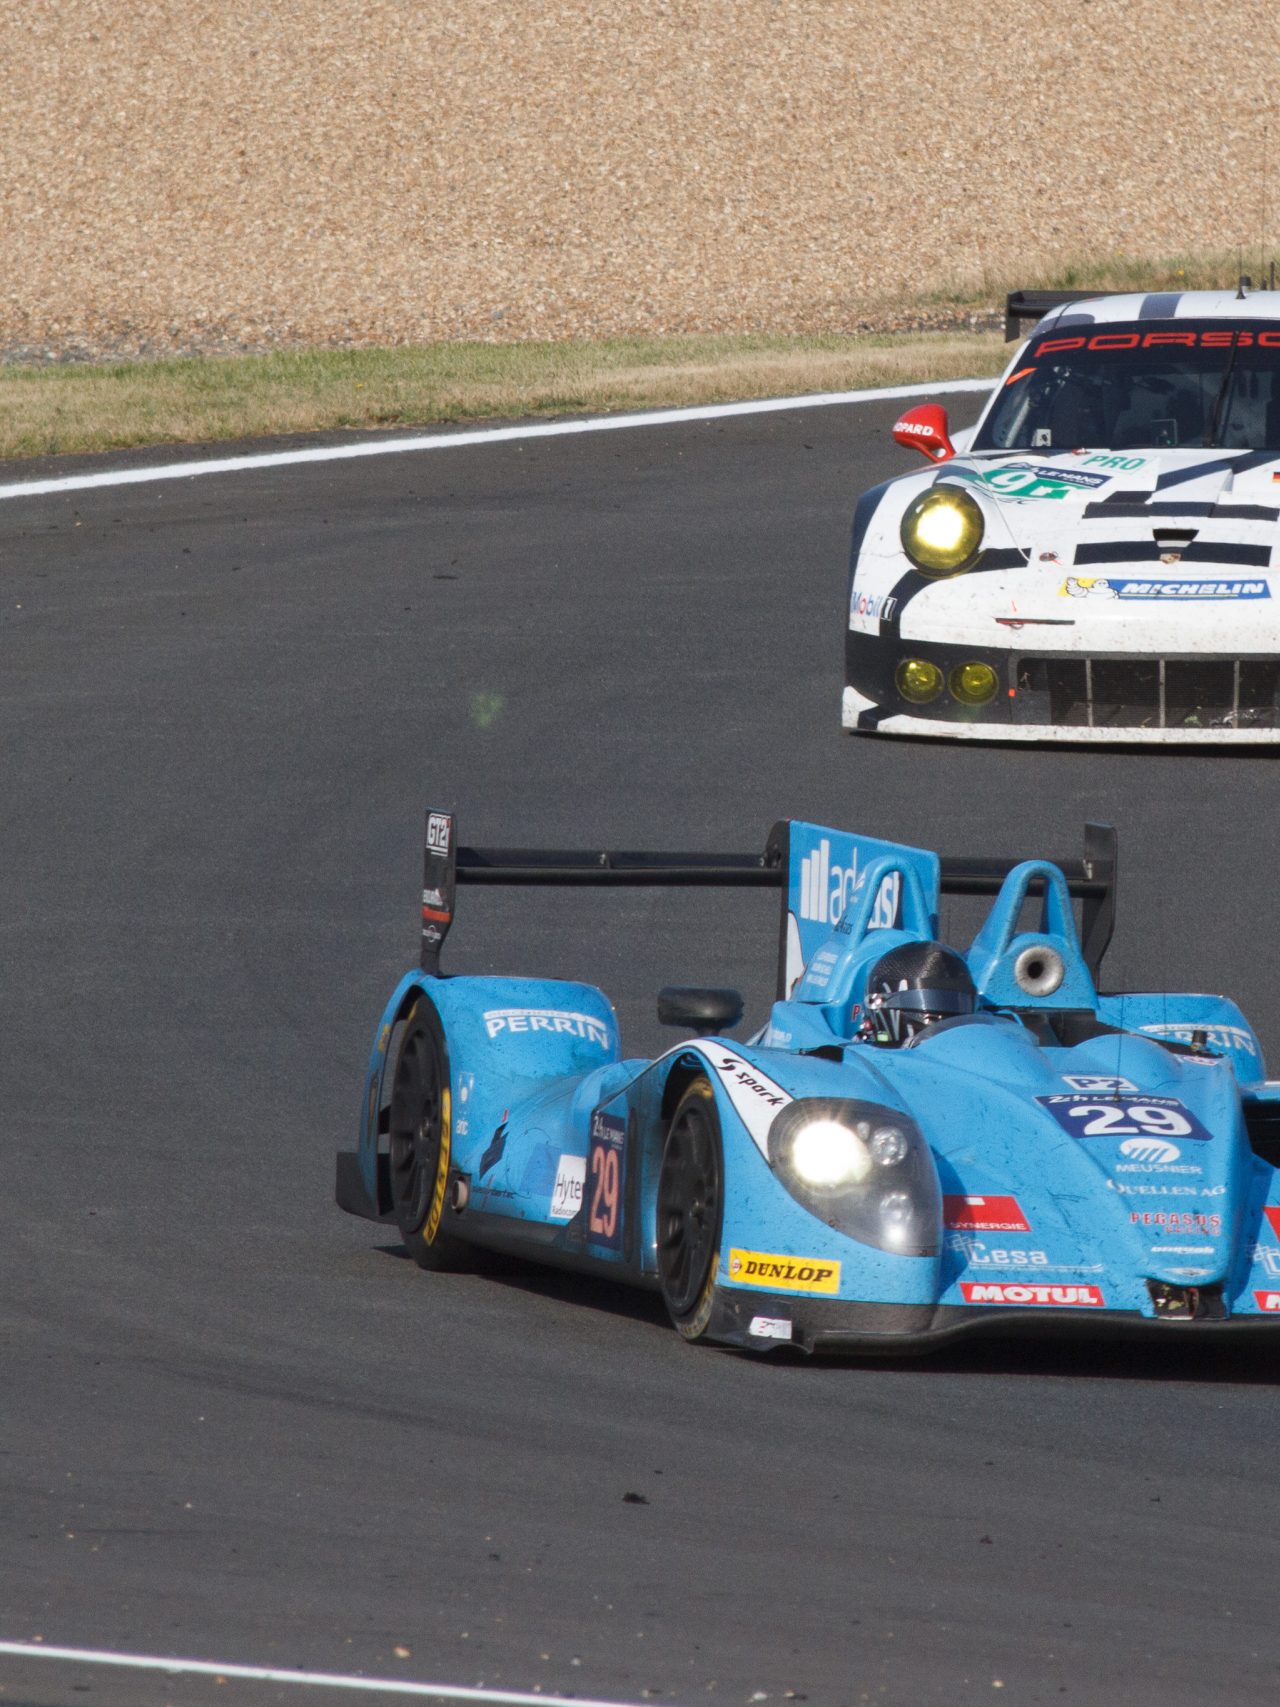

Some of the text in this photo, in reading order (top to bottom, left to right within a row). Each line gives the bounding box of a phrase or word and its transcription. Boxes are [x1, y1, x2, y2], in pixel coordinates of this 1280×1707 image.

[1081, 455, 1146, 471] PRO
[1121, 583, 1265, 594] MICHELIN
[486, 1016, 608, 1050] PERRIN
[735, 1071, 784, 1106] spark
[1073, 1078, 1131, 1089] P2
[1068, 1105, 1192, 1136] 29
[1115, 1164, 1202, 1174] MEUSNIER
[590, 1146, 618, 1238] 29
[950, 1222, 1026, 1231] SYNERGIE
[1130, 1212, 1221, 1226] PEGASUS
[970, 1242, 1049, 1265] Cesa
[745, 1261, 833, 1282] DUNLOP
[970, 1285, 1098, 1304] MOTUL
